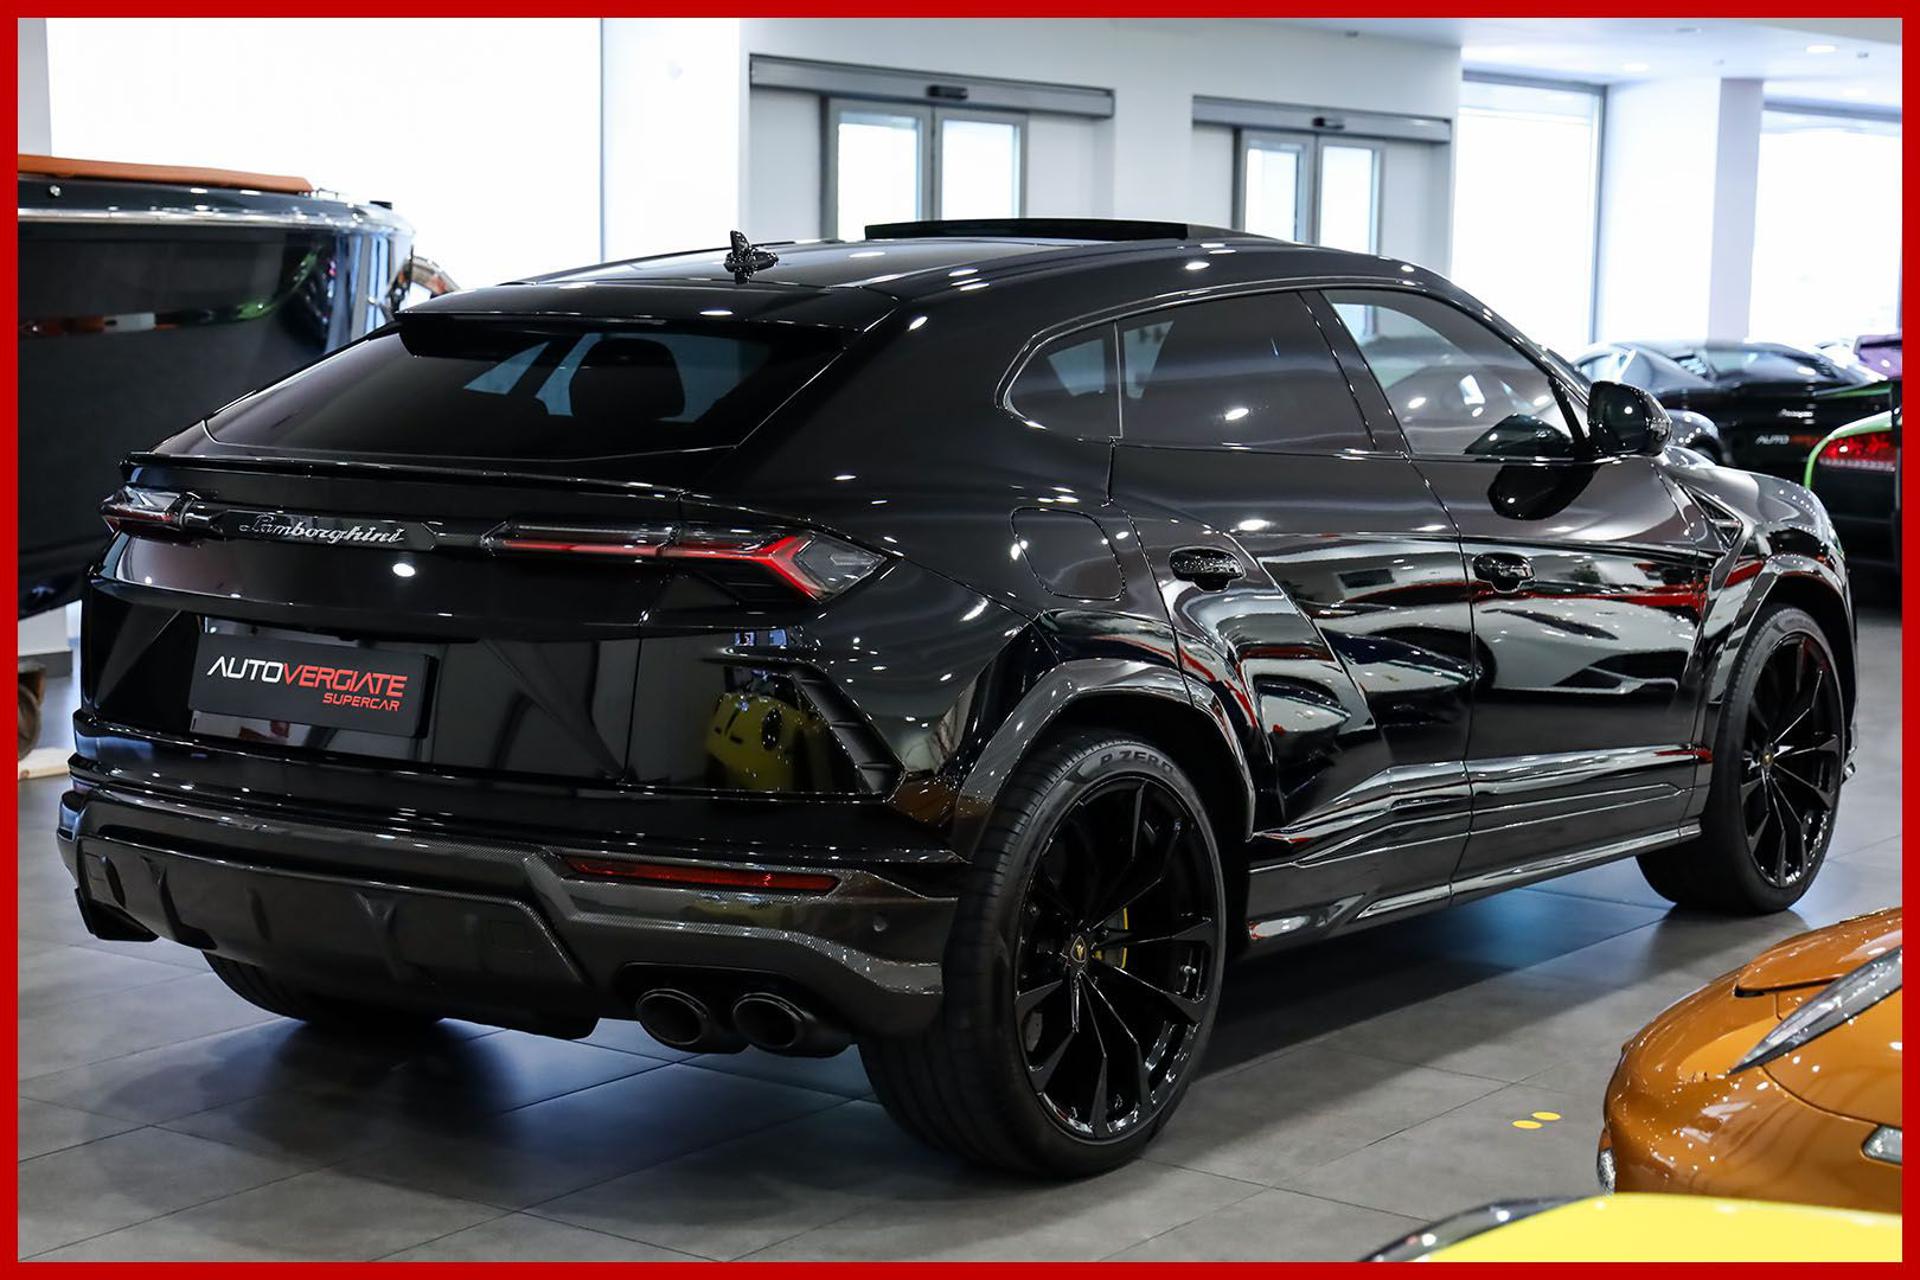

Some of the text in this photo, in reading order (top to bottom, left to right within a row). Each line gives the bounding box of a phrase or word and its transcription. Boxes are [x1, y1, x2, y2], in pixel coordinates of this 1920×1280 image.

[239, 512, 405, 544] Lamborghini
[206, 656, 408, 698] AUTOVERGIATE
[322, 692, 401, 712] SUPERCAR
